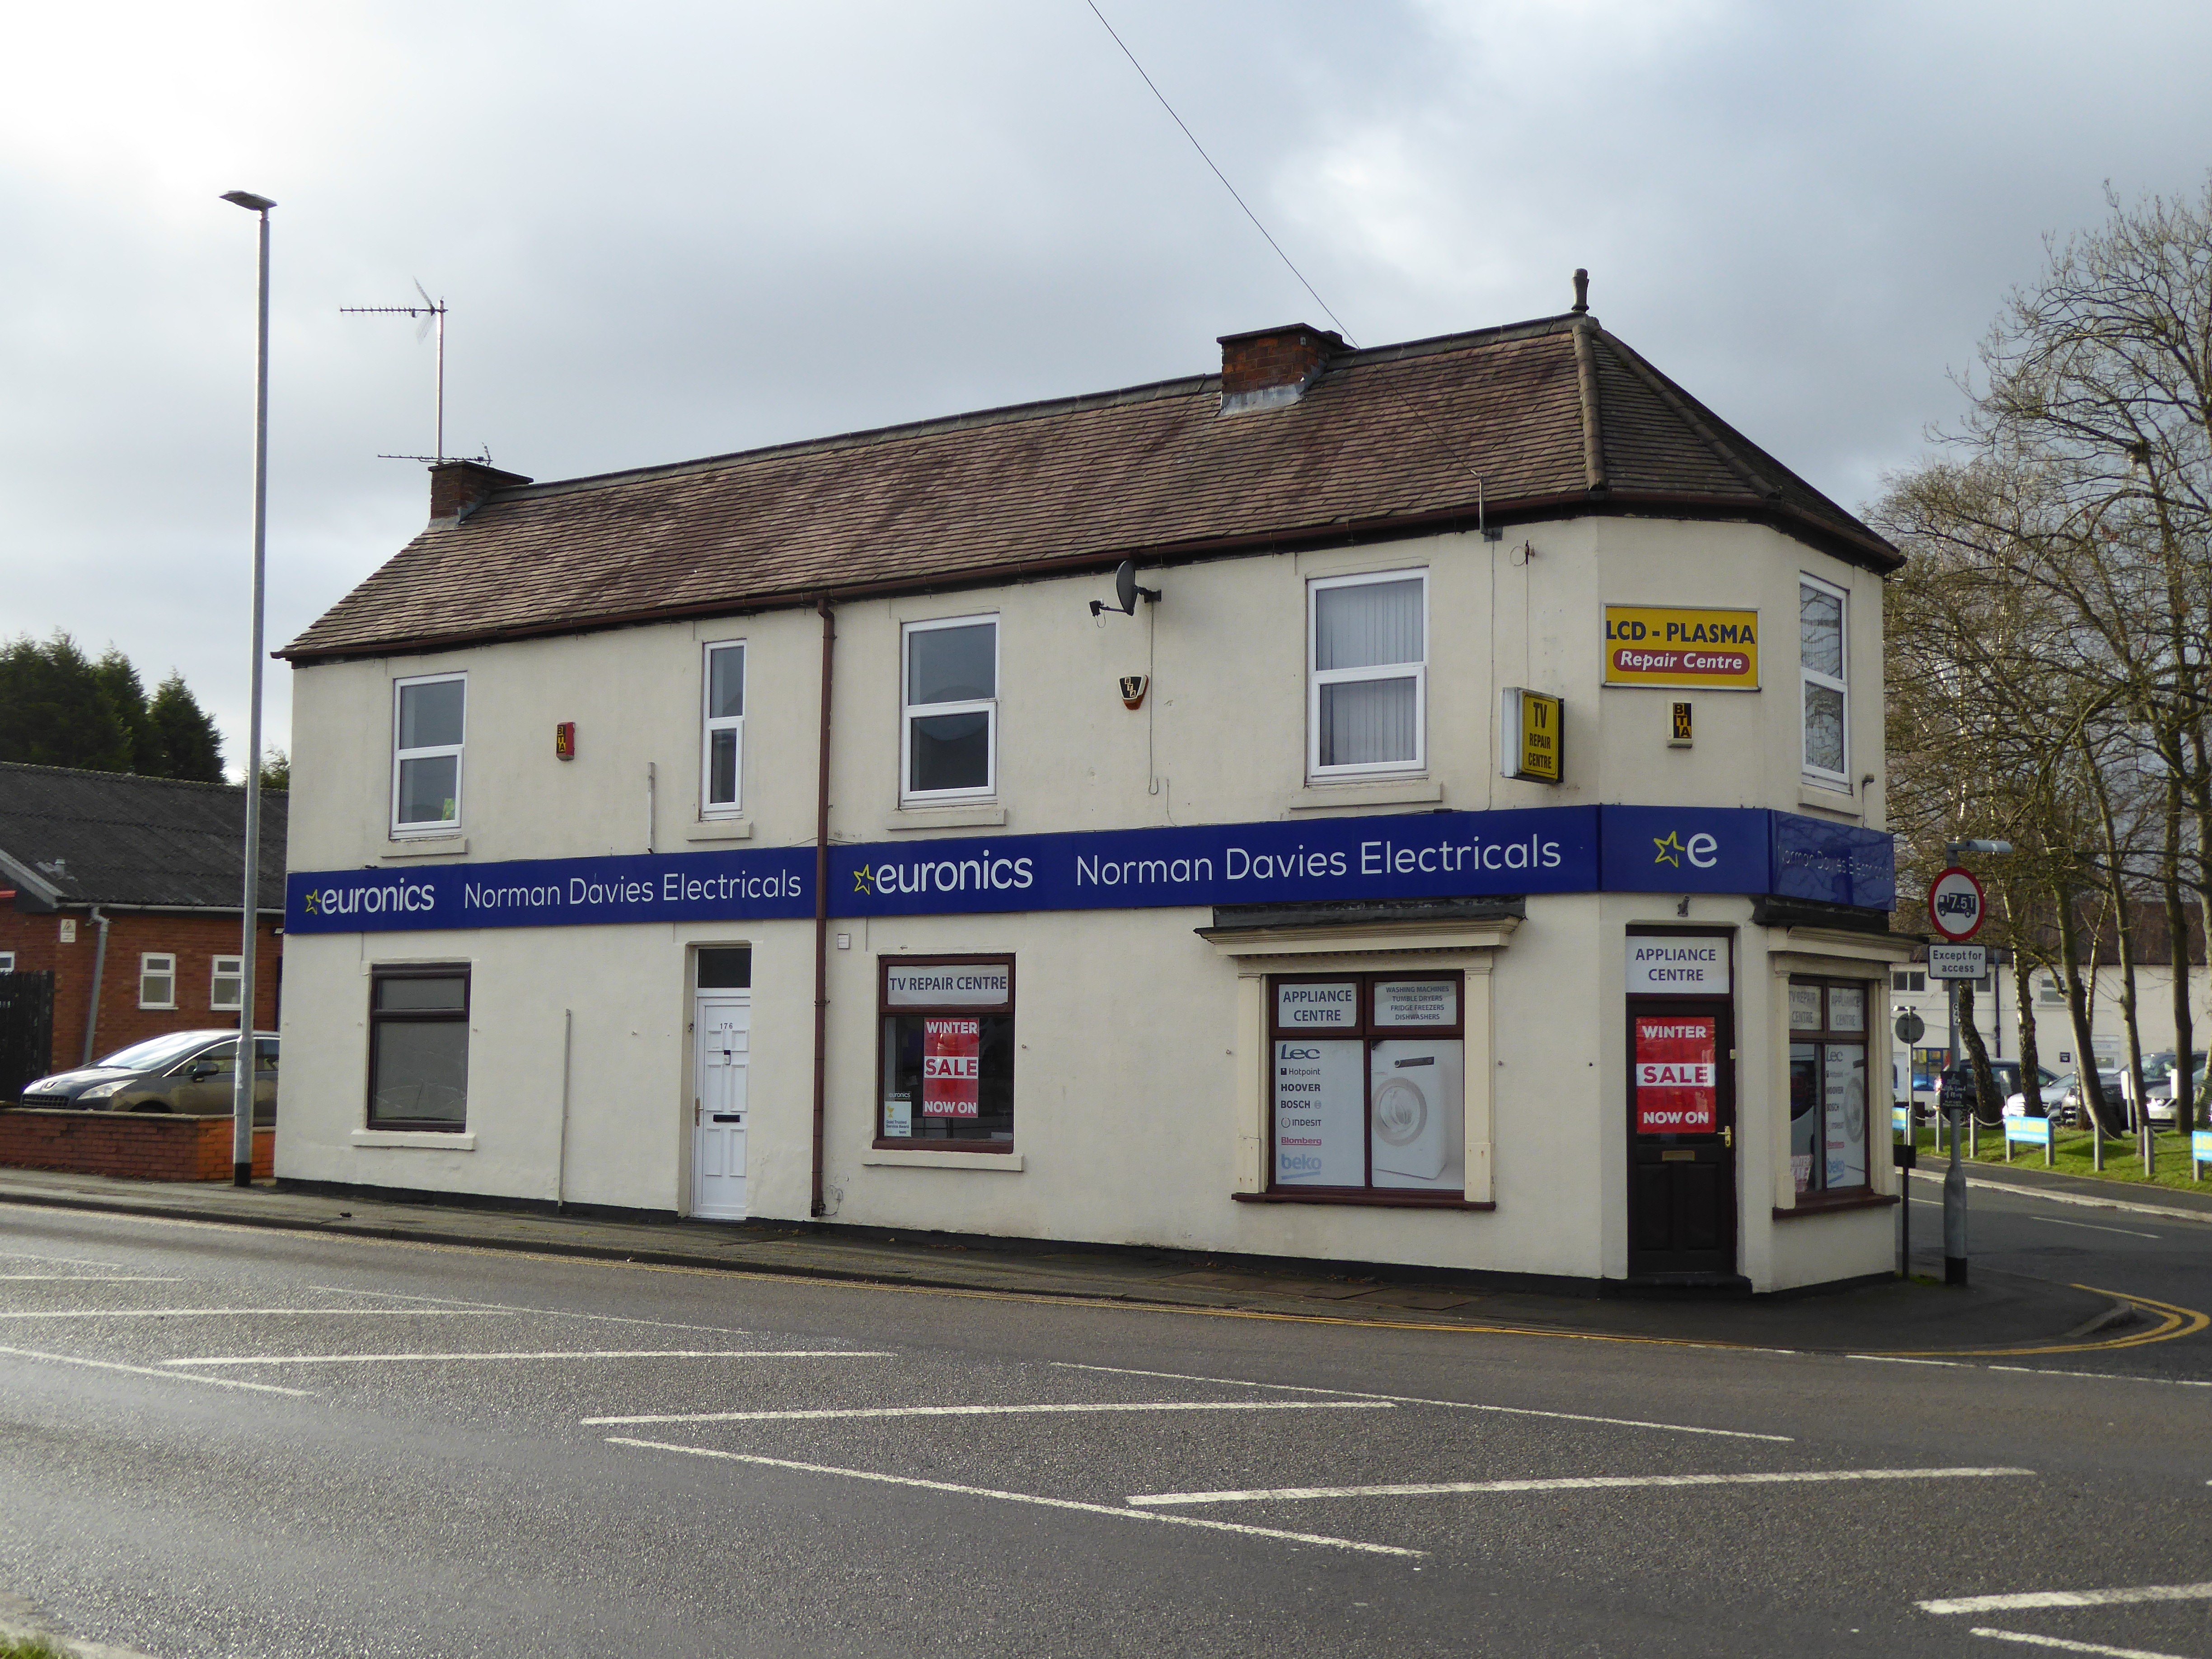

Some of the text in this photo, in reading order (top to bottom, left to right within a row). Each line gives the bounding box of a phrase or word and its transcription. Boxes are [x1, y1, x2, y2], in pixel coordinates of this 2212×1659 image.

[1606, 621, 1646, 640] LCD
[1667, 623, 1755, 644] PLASMA
[1621, 651, 1742, 670] Repair Centre
[1533, 702, 1547, 728] TV
[1529, 732, 1551, 750] REPAIR
[1528, 752, 1551, 769] CENTRE
[875, 834, 1561, 894] euronics Norman Davies Electricals
[321, 869, 801, 914] euronics Norman Davies Electricals
[1636, 948, 1716, 961] APPLIANCE
[1933, 950, 1982, 961] Except for
[1942, 964, 1974, 972] access
[1649, 969, 1703, 981] CENTRE
[890, 976, 1007, 990] TV REPAIR CENTRE
[1283, 990, 1352, 1003] APPLIANCE
[1294, 1009, 1341, 1021] CENTRE
[926, 1022, 977, 1034] WINTER
[1642, 1026, 1706, 1038] WINTER
[1281, 1044, 1320, 1059] Lec
[926, 1059, 977, 1076] SALE
[1289, 1068, 1321, 1077] Hotpoint
[1644, 1066, 1708, 1083] SALE
[924, 1101, 976, 1114] NOW ON
[1281, 1100, 1310, 1108] BOSCH
[1644, 1111, 1709, 1124] NOW ON
[1281, 1137, 1322, 1146] Blomberg
[1281, 1153, 1322, 1170] beko
